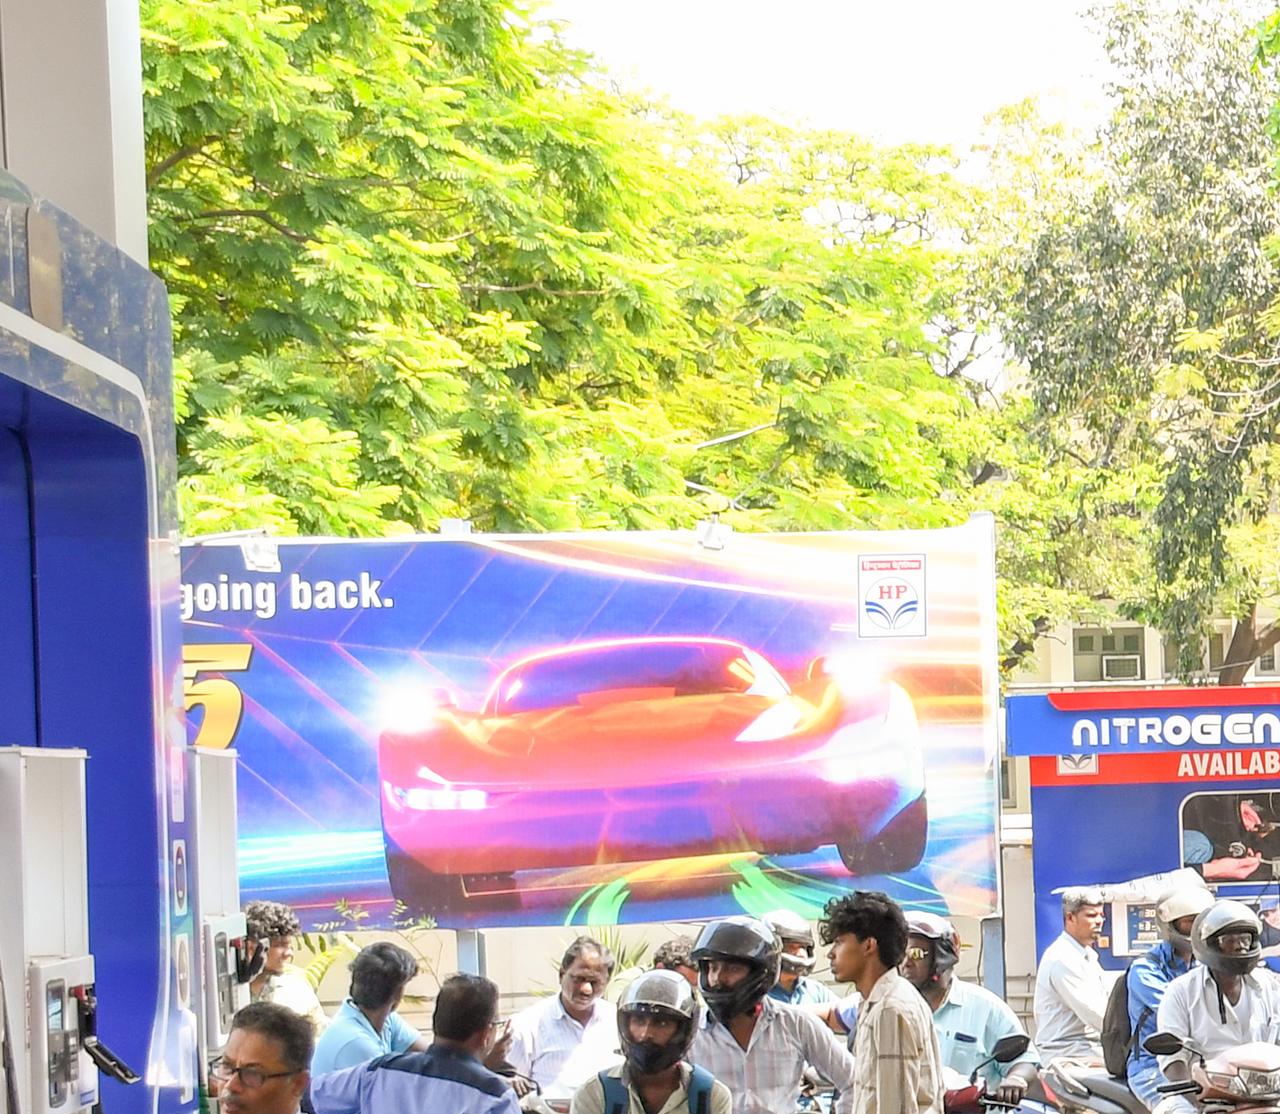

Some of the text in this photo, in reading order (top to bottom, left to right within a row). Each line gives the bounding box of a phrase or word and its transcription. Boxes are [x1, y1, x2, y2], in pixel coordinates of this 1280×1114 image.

[180, 572, 394, 619] going back.
[878, 585, 907, 600] HP
